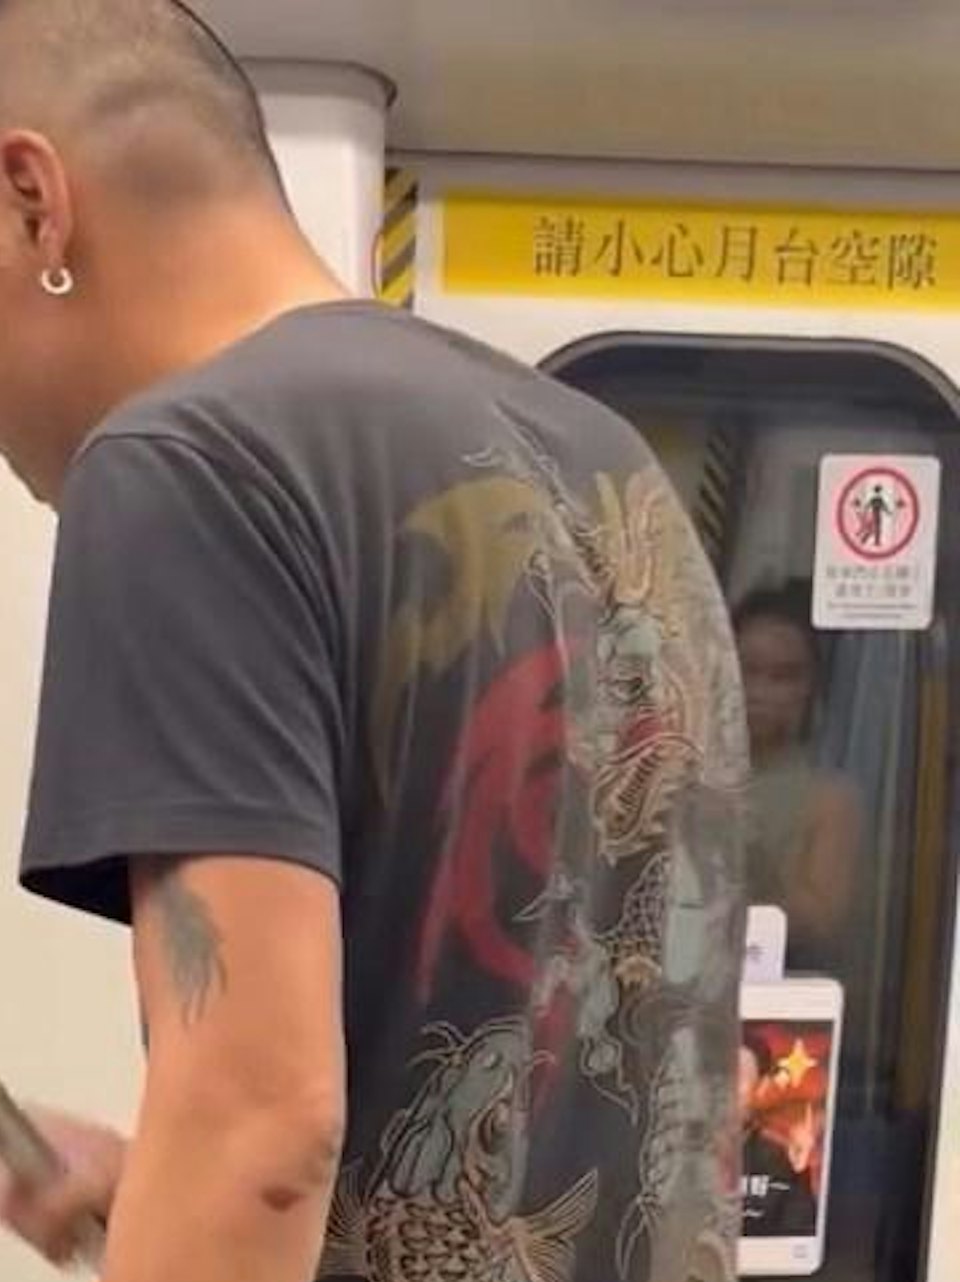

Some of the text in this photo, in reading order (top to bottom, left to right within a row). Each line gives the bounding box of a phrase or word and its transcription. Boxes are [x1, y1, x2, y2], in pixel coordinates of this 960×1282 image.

[534, 214, 938, 291] 請小心月台空隙
